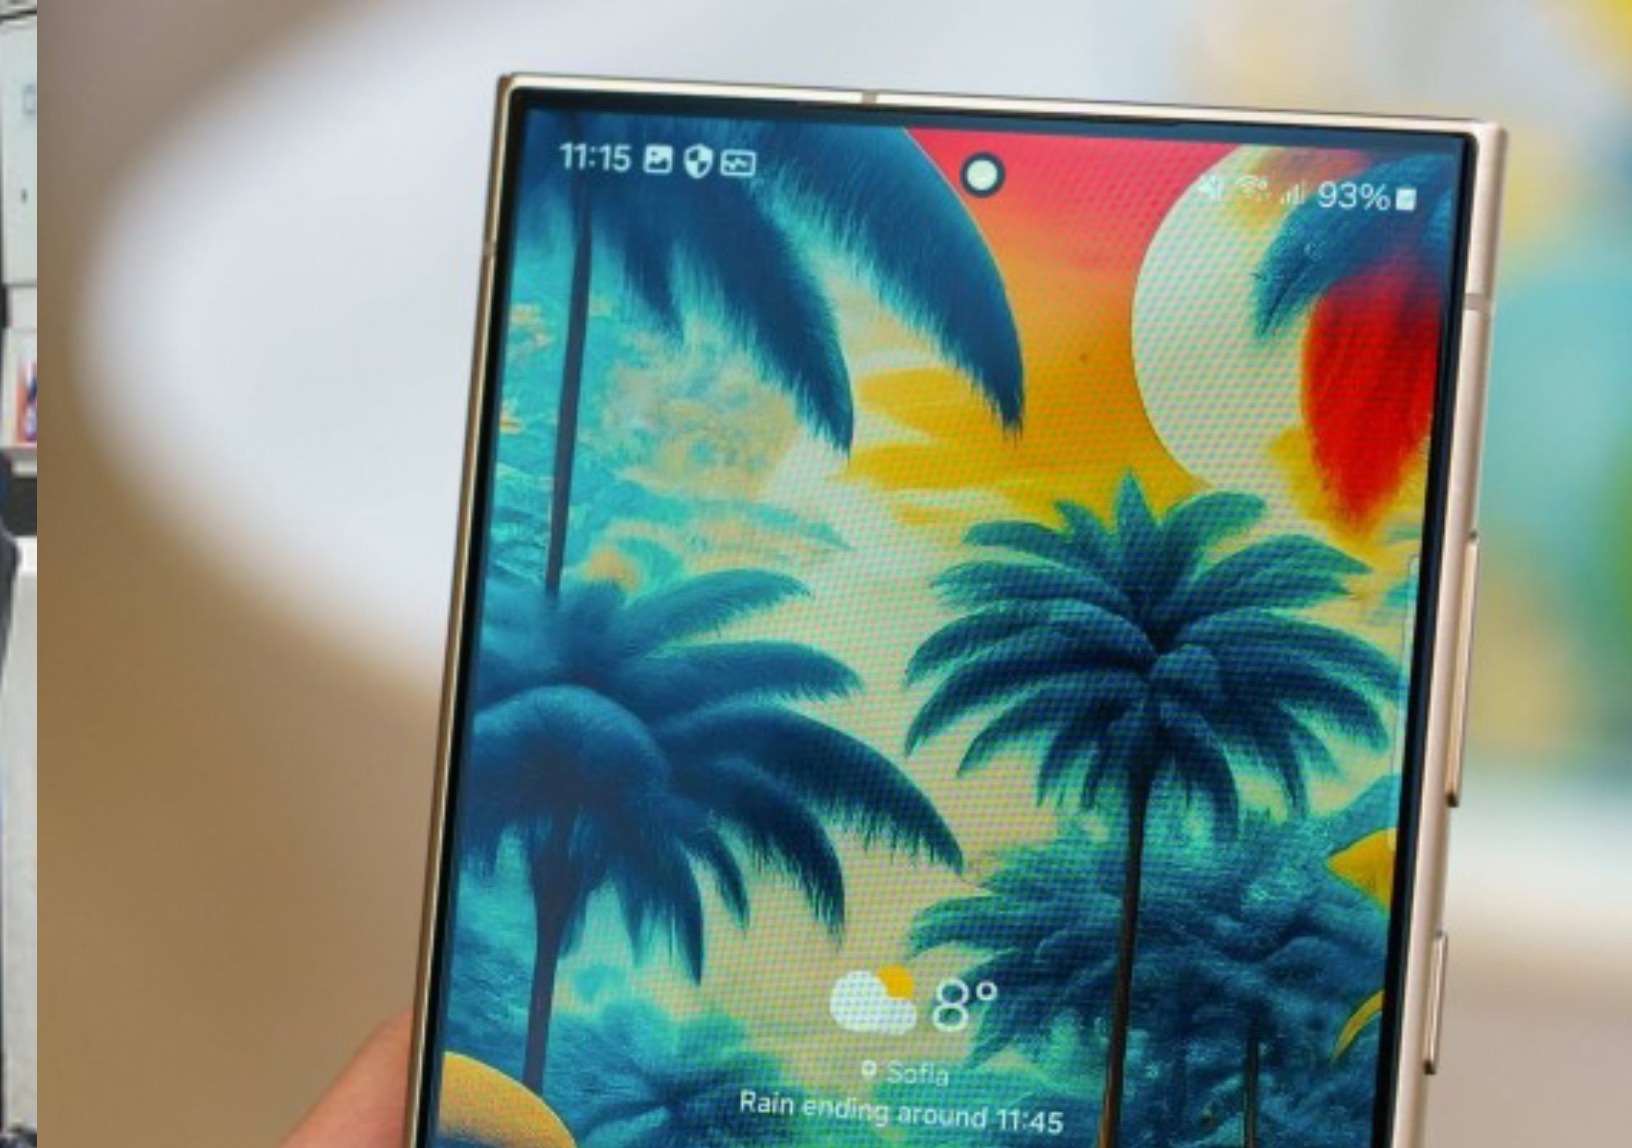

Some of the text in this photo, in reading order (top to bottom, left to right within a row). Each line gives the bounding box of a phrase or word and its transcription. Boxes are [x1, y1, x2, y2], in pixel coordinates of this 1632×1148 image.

[559, 142, 632, 172] 11:15
[1318, 180, 1391, 211] 93%
[932, 979, 998, 1033] 8°
[886, 1062, 950, 1087] Sofia
[739, 1089, 1064, 1135] Rain ending around 11:45
